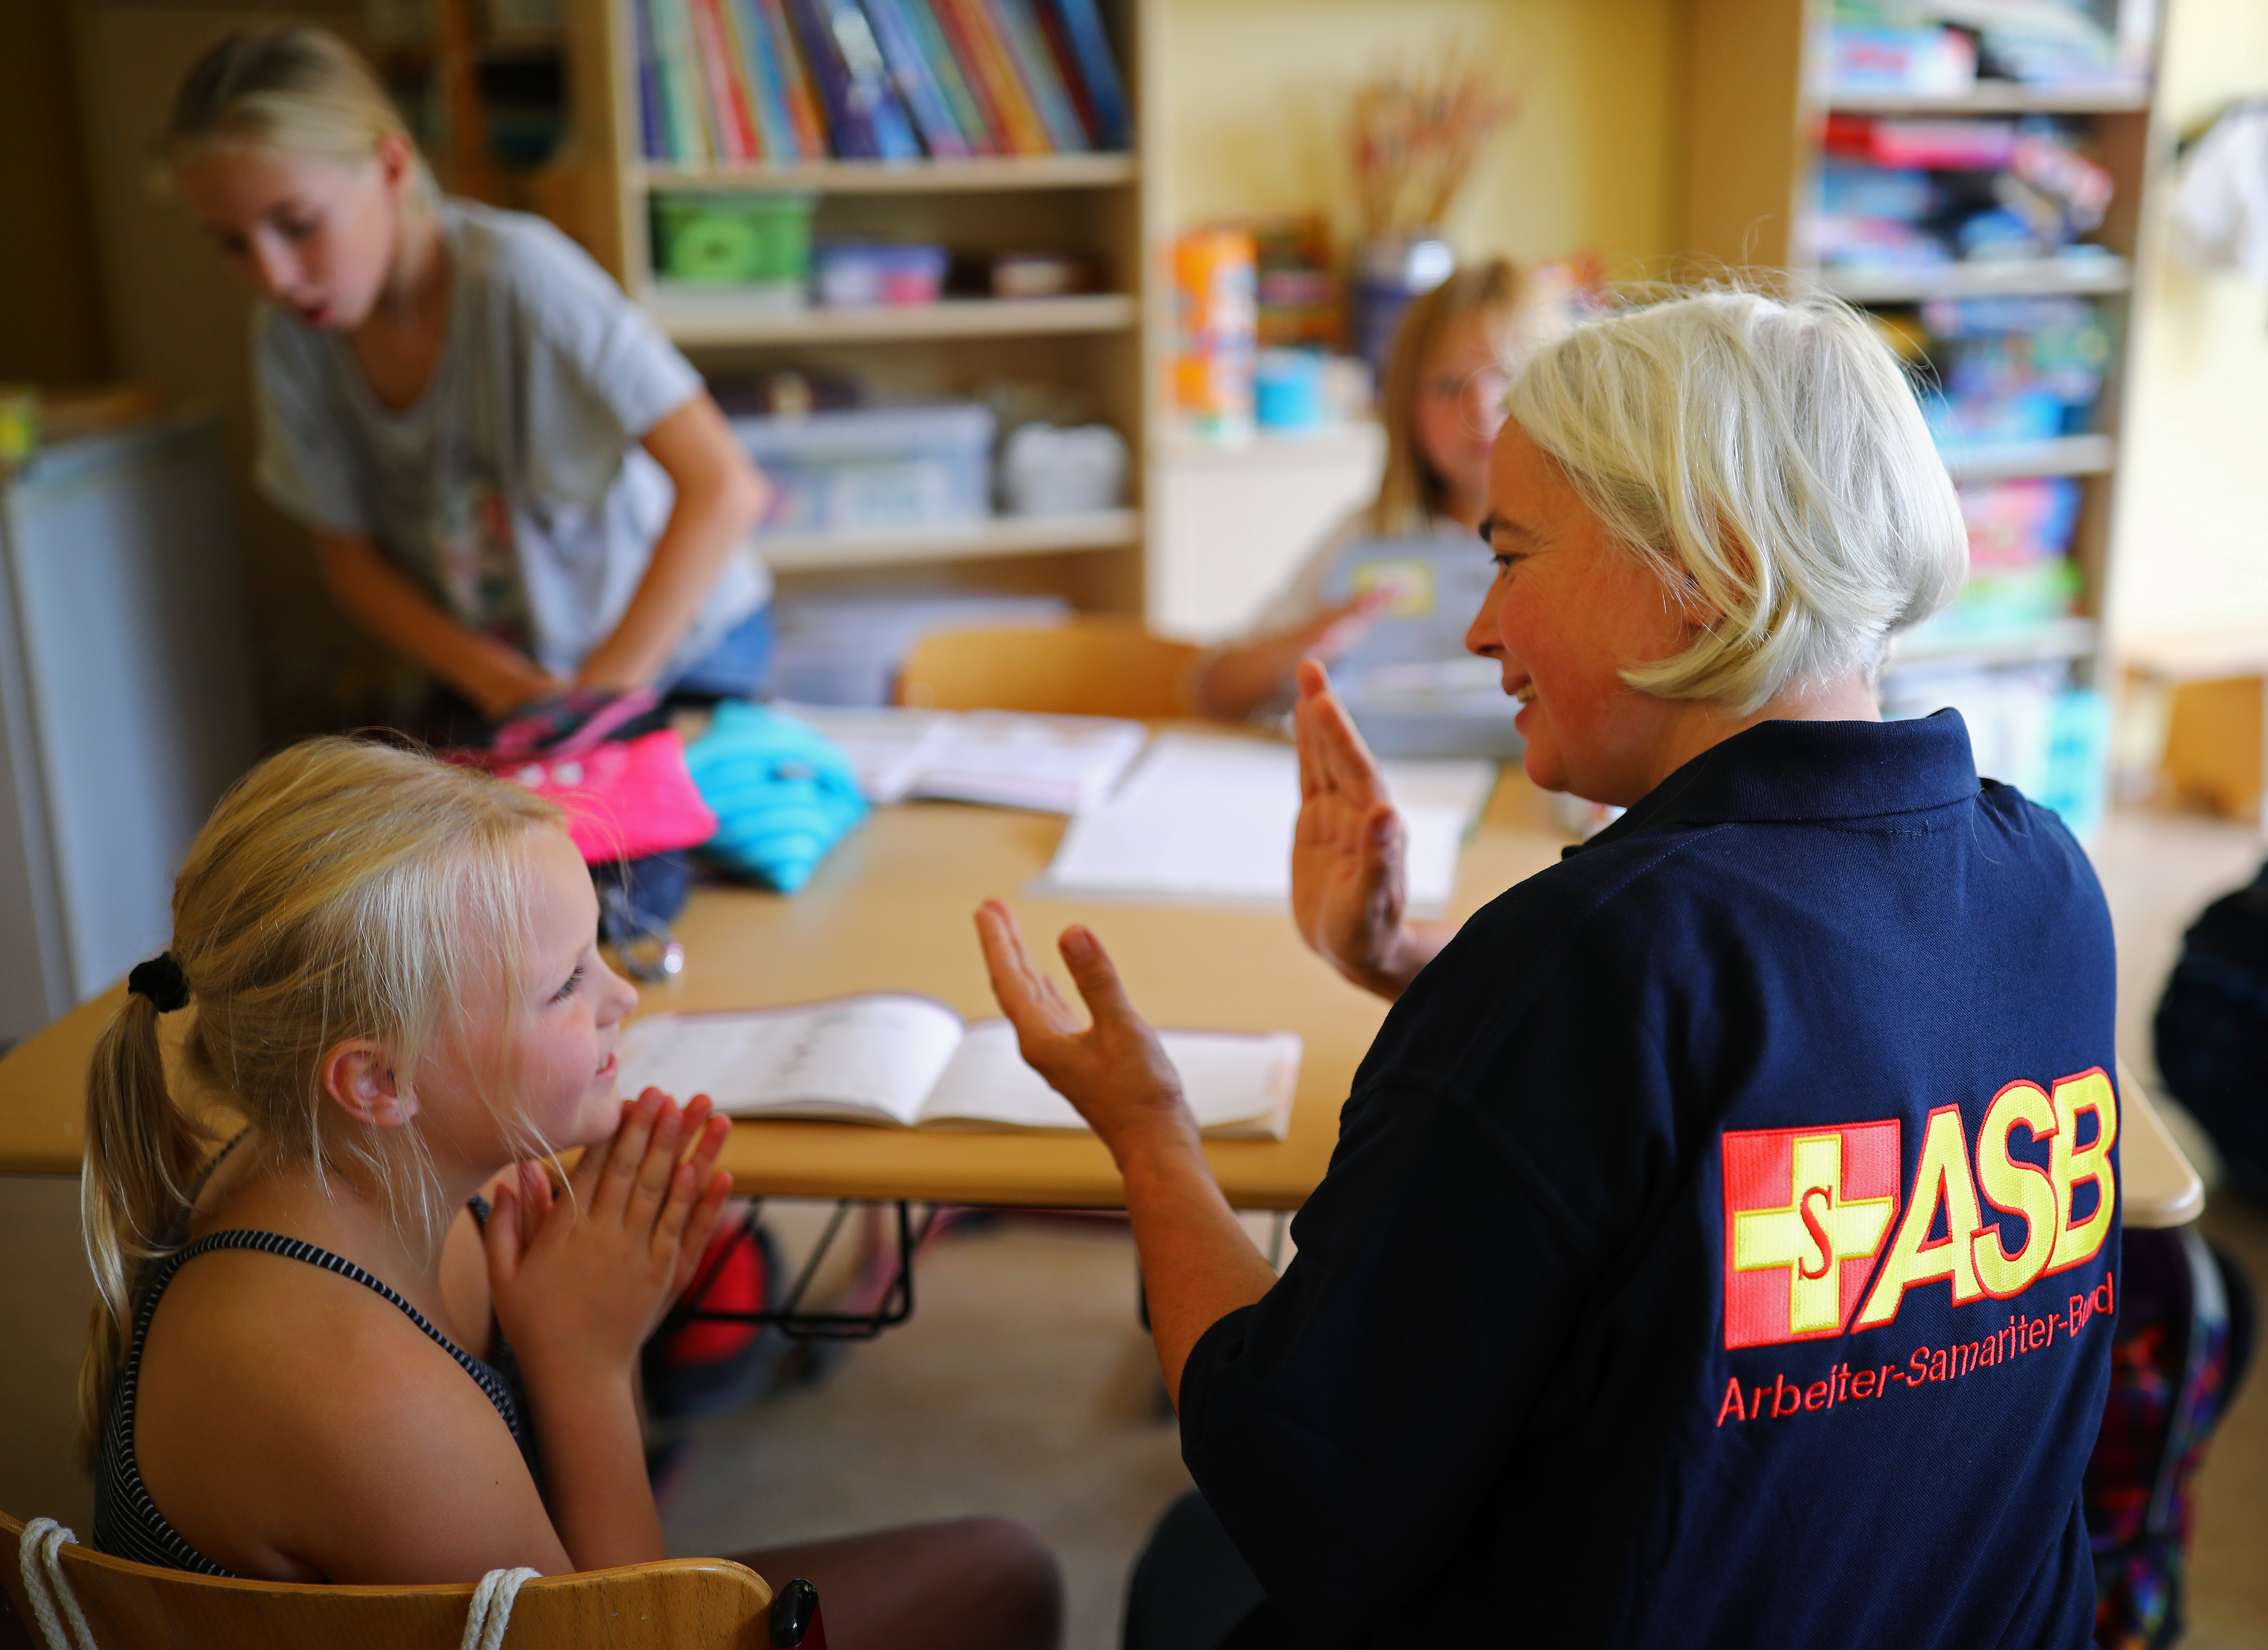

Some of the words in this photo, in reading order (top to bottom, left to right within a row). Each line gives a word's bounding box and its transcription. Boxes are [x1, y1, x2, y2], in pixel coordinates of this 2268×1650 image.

[1799, 1185, 1832, 1280] S
[1849, 1066, 2117, 1334] ASB
[1716, 1271, 2114, 1428] Arbeiter-Samariter-Bd
